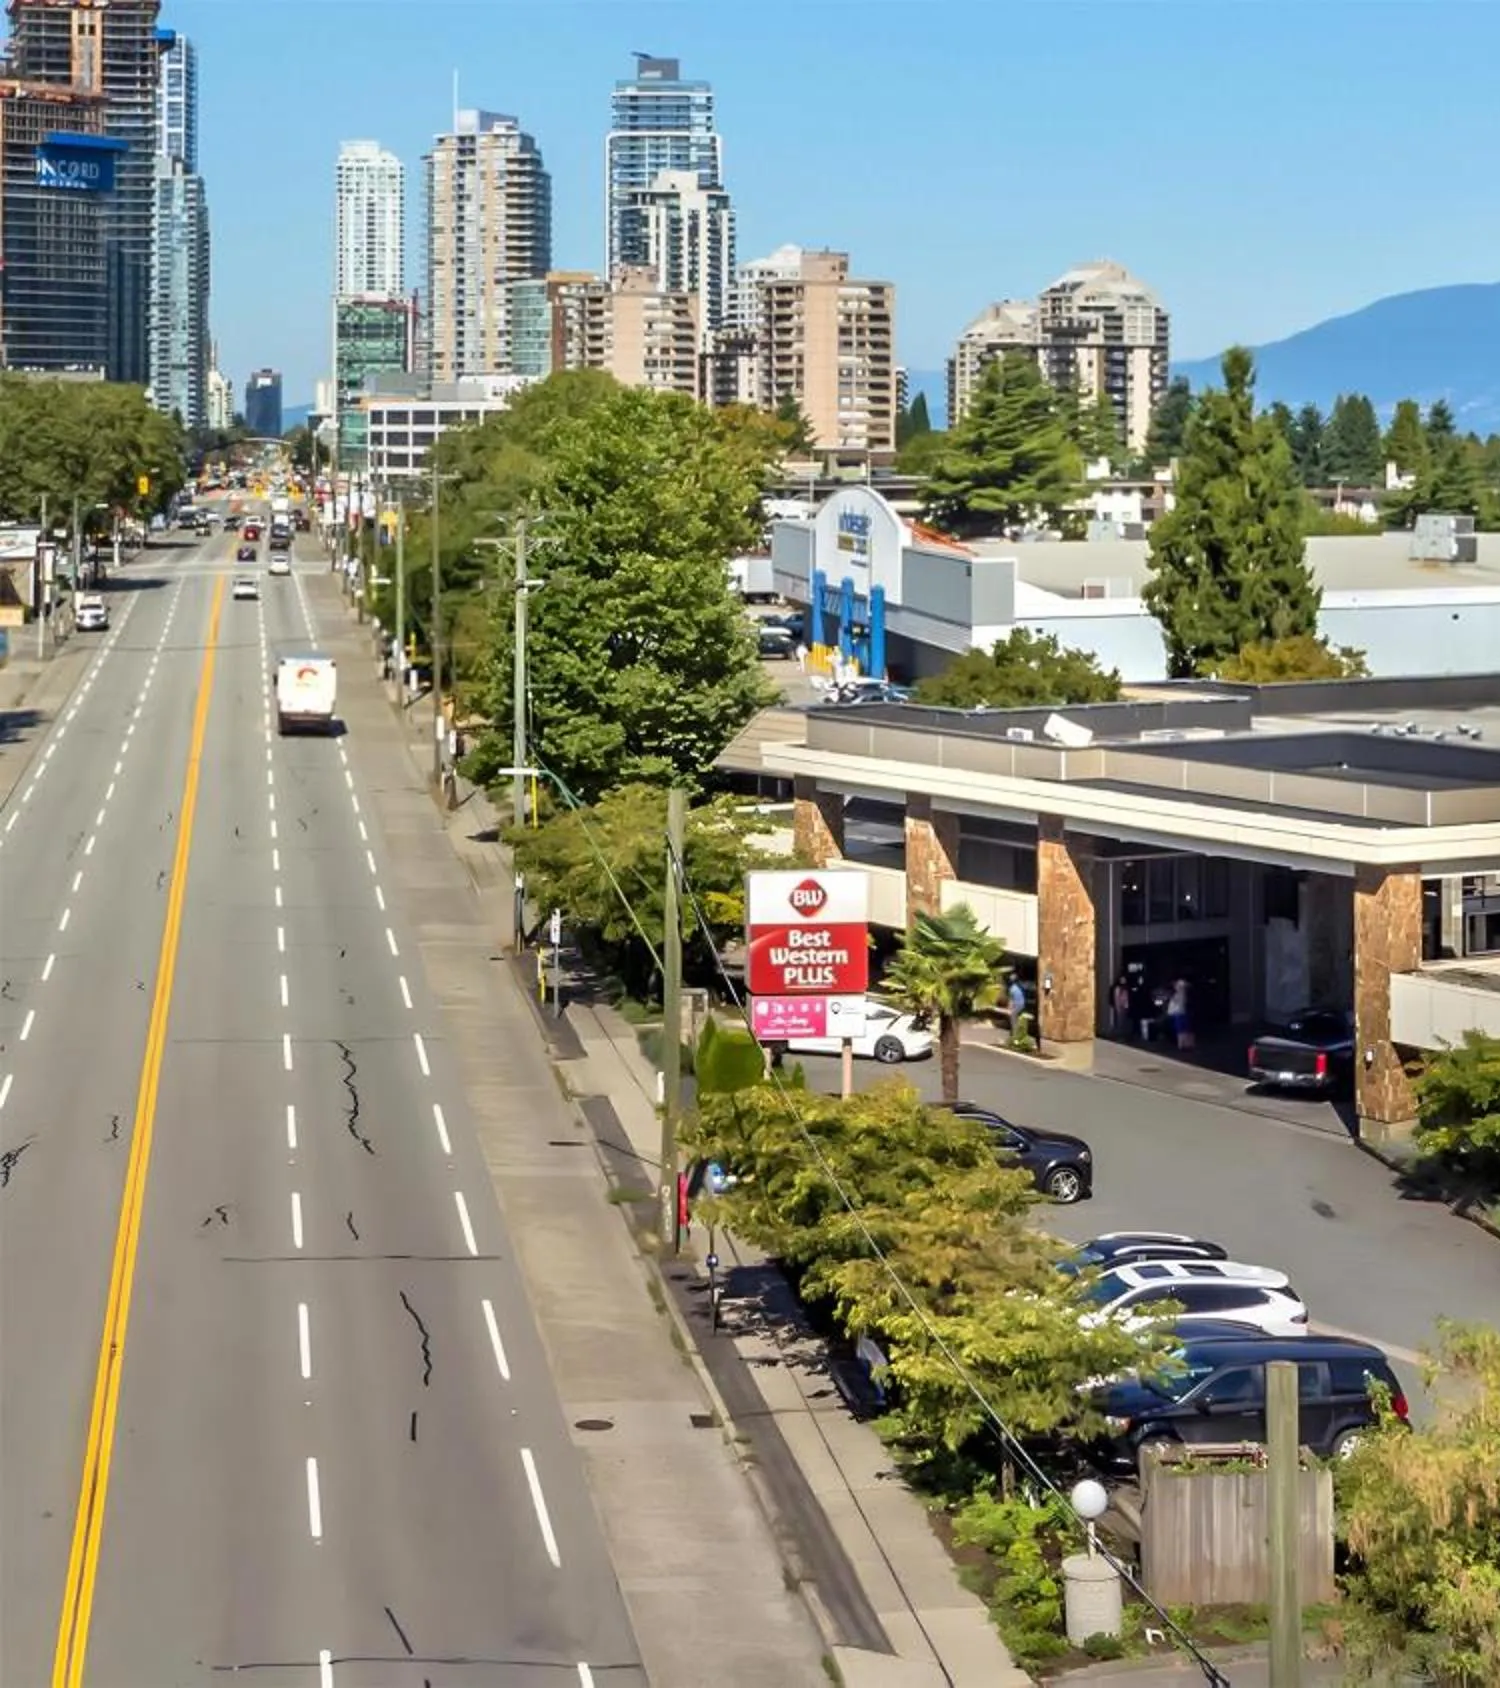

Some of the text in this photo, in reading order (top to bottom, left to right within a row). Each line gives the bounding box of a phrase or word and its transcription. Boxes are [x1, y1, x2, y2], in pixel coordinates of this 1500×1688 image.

[793, 889, 823, 907] BW
[788, 930, 831, 947] Best
[769, 948, 848, 965] Western
[784, 967, 834, 985] PLUS
